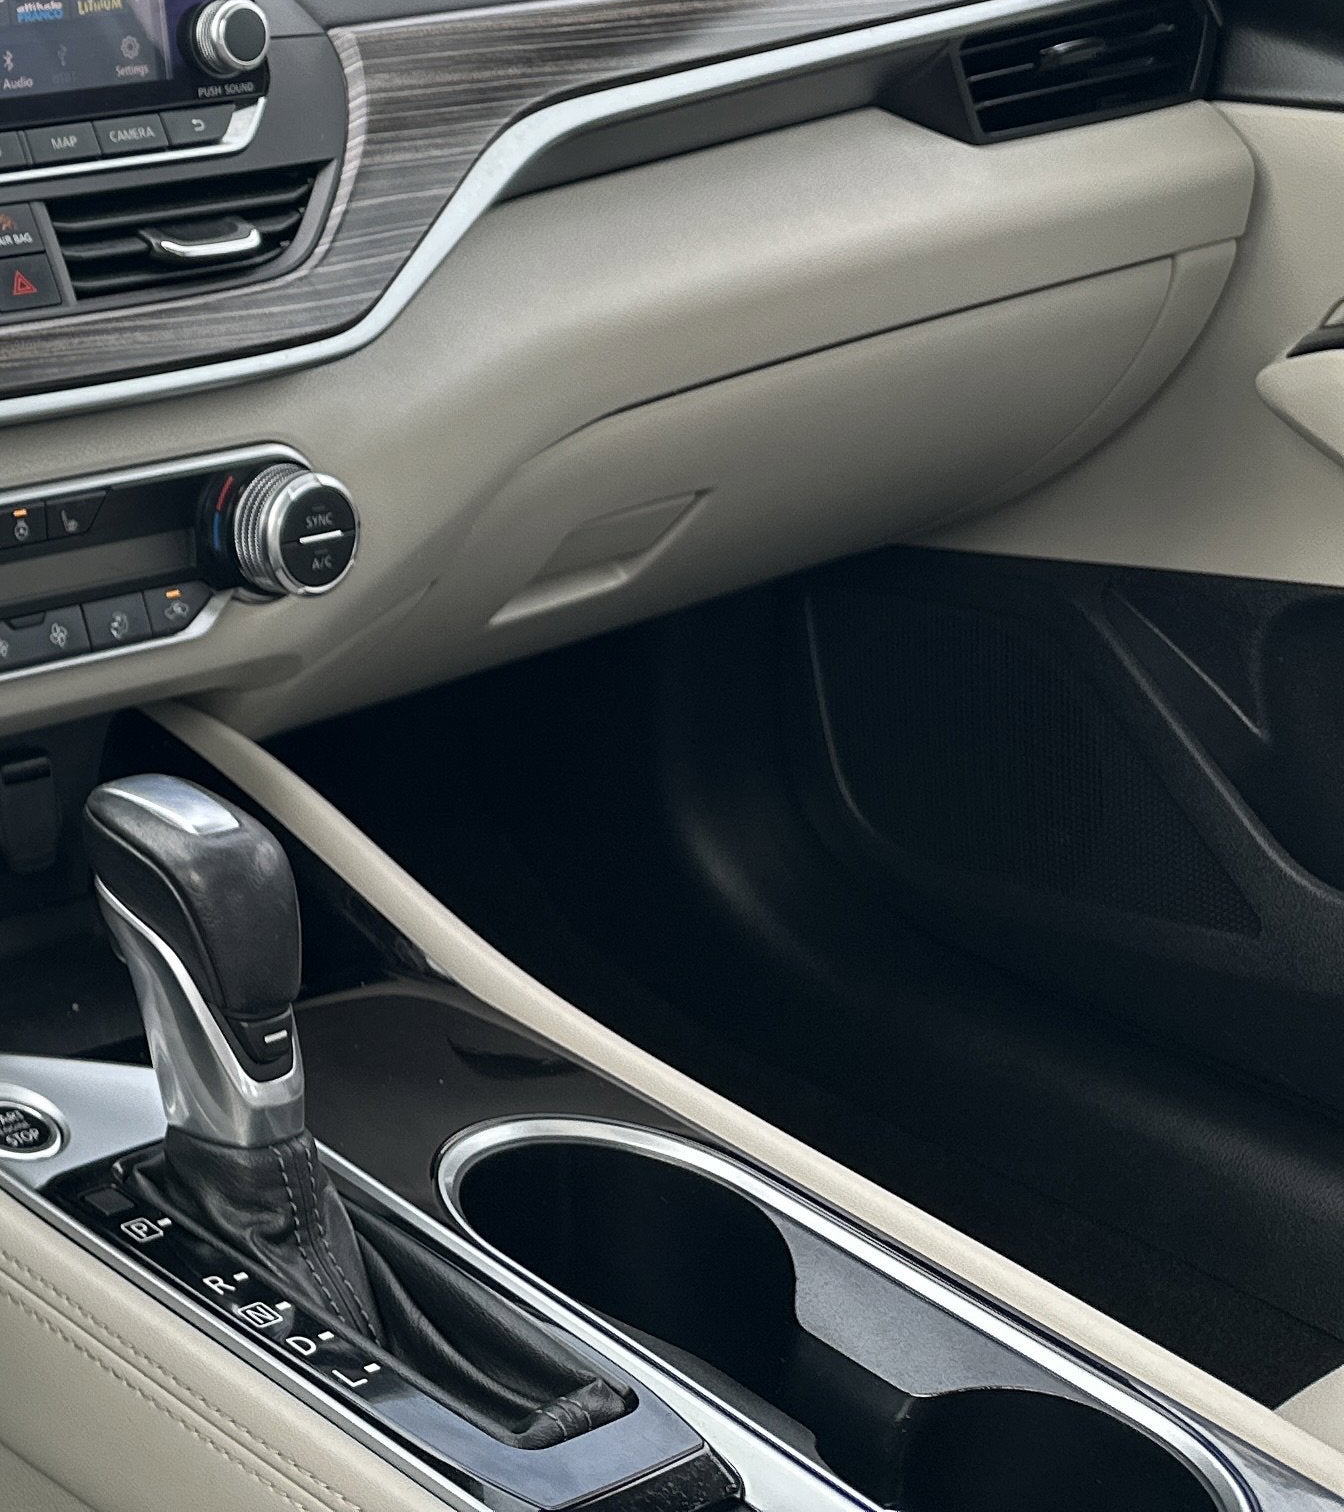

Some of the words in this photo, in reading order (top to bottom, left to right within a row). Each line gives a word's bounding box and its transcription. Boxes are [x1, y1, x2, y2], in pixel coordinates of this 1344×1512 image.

[115, 63, 150, 78] Settings
[3, 76, 34, 90] Audio
[50, 135, 78, 150] MAP
[109, 126, 155, 143] CAMERA
[305, 511, 333, 529] SYNC
[311, 554, 332, 569] A/C
[6, 1128, 40, 1147] STOP
[130, 1222, 148, 1238] P
[202, 1275, 236, 1295] R
[246, 1306, 276, 1324] N
[286, 1336, 317, 1356] D
[331, 1369, 368, 1387] L
